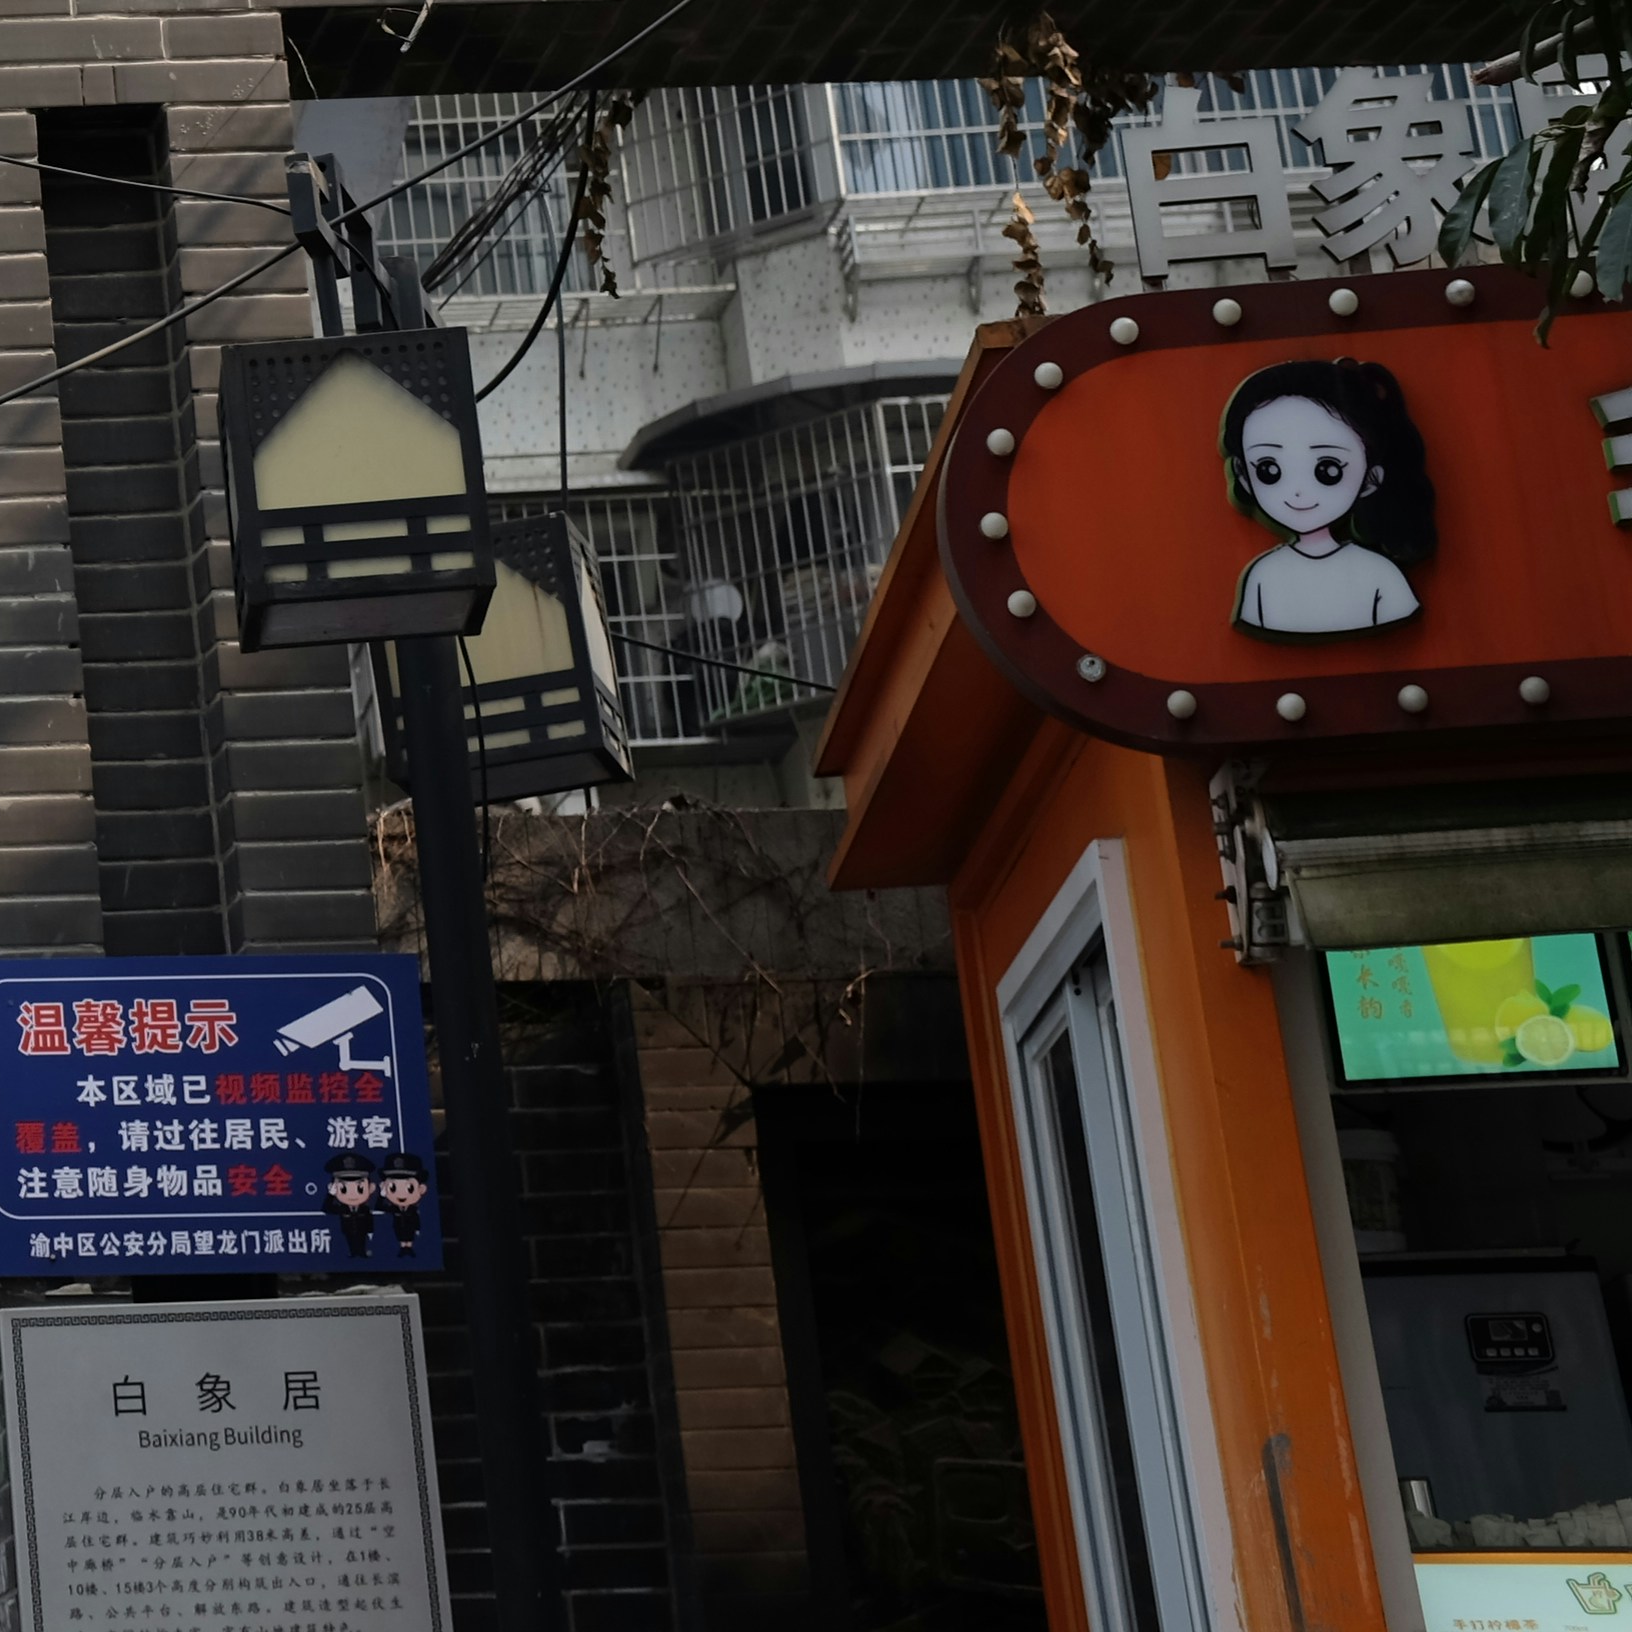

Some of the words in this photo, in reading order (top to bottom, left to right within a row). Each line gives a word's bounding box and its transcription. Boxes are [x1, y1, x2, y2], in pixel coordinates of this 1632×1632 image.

[17, 999, 238, 1056] 温馨提示
[76, 1071, 384, 1107] 本区域已视频监控全
[29, 1230, 331, 1259] 渝中区公安分局望龙门派出所
[112, 1371, 321, 1417] 白象居
[138, 1428, 221, 1451] Baixiang
[224, 1425, 304, 1449] Building
